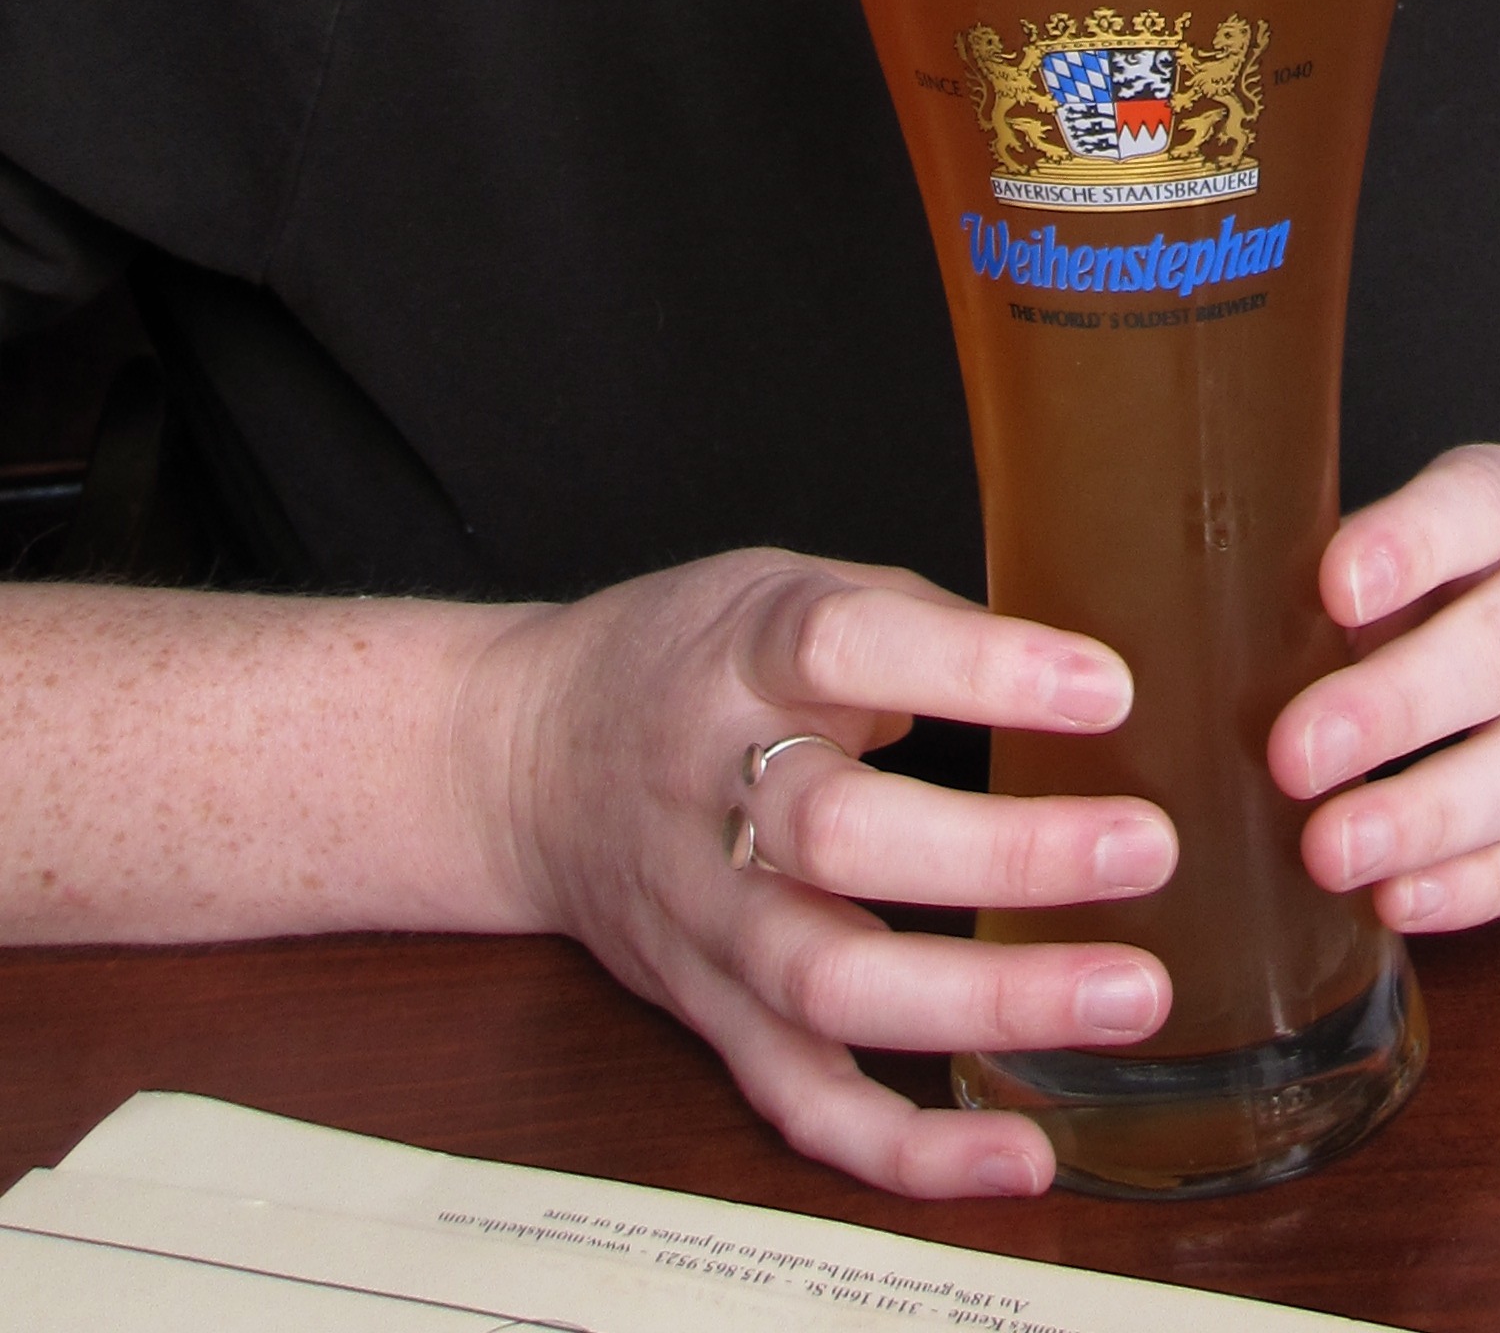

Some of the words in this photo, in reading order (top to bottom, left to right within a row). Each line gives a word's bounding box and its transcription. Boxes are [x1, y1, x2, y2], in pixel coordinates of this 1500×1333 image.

[1274, 60, 1313, 85] 1040
[993, 178, 1098, 204] BAYERISCHE
[960, 212, 1291, 297] Weihenstephan
[1009, 302, 1036, 322] THE
[1122, 307, 1190, 330] OLDEST
[1196, 291, 1268, 323] BREWERY
[543, 1208, 590, 1226] more
[592, 1216, 609, 1229] or
[614, 1220, 626, 1233] 6
[437, 1209, 632, 1253] www.monkskettle.com
[627, 1223, 648, 1237] of
[649, 1226, 712, 1248] parties
[711, 1235, 736, 1256] all
[739, 1244, 757, 1256] to
[655, 1249, 776, 1286] 415.865.9523
[760, 1246, 815, 1271] added
[817, 1259, 841, 1277] be
[841, 1265, 879, 1283] will
[881, 1271, 955, 1297] gratuity
[804, 1279, 826, 1297] St.
[831, 1284, 870, 1306] 16th
[955, 1288, 995, 1309] 18%
[875, 1291, 923, 1315] 3141
[1000, 1296, 1030, 1314] An
[948, 1307, 1007, 1332] Kettle
